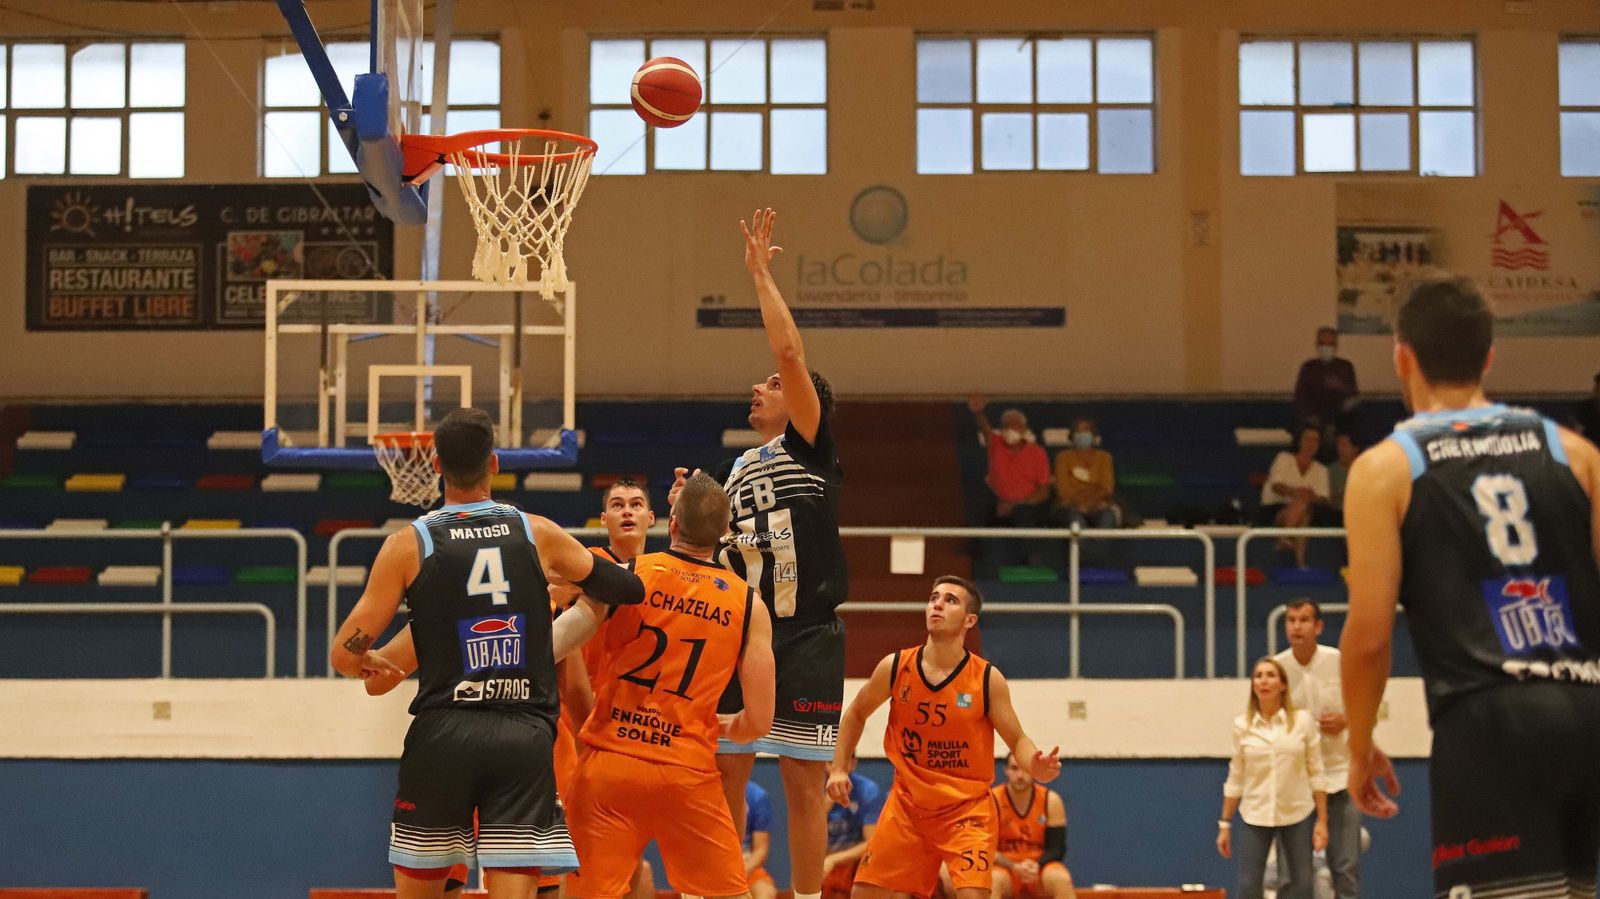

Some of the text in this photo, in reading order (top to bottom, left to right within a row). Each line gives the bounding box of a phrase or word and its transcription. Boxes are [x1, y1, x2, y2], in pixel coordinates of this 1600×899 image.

[245, 207, 271, 223] DE
[276, 207, 375, 223] GIBRALTAR
[49, 268, 196, 290] RESTAURANTE
[797, 253, 967, 286] laColada
[49, 296, 194, 318] BUFFET LIBRE
[1471, 471, 1539, 567] 8
[449, 523, 511, 540] MATOSO
[466, 546, 511, 606] 4
[774, 561, 796, 583] 14
[466, 638, 521, 670] UBAGO
[617, 619, 707, 702] 21
[486, 678, 530, 701] STROG
[611, 707, 682, 738] ENRIQUE
[915, 702, 947, 727] 55
[617, 726, 671, 748] SOLER
[815, 723, 834, 746] 14
[927, 739, 969, 750] MELILLA
[927, 750, 962, 760] SPORT
[927, 759, 970, 770] CAPITAL
[960, 849, 989, 872] 55
